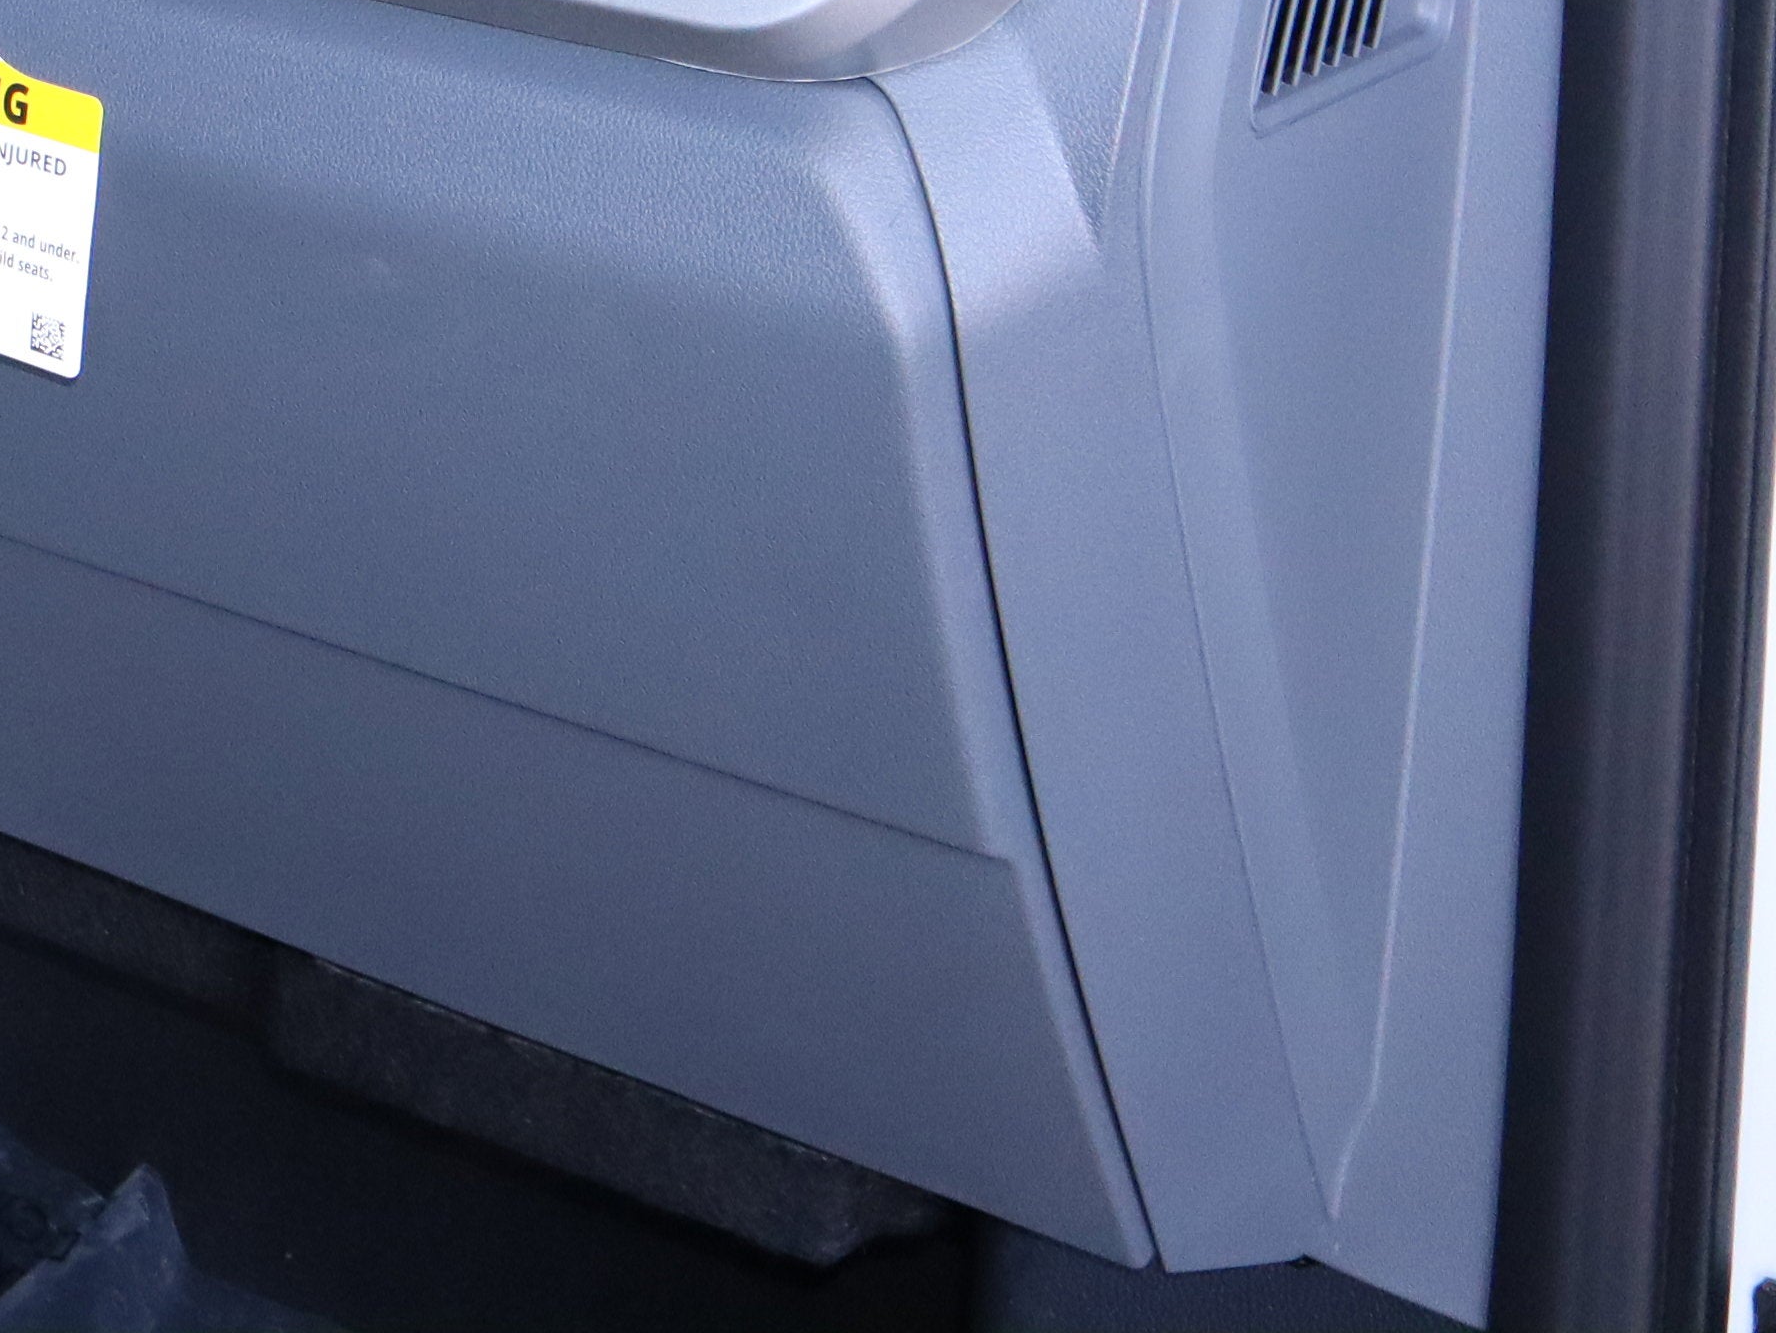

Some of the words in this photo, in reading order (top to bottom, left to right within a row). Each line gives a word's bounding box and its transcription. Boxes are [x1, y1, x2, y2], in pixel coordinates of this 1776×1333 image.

[13, 229, 35, 250] and
[39, 238, 79, 264] under.
[19, 259, 53, 281] seats.
